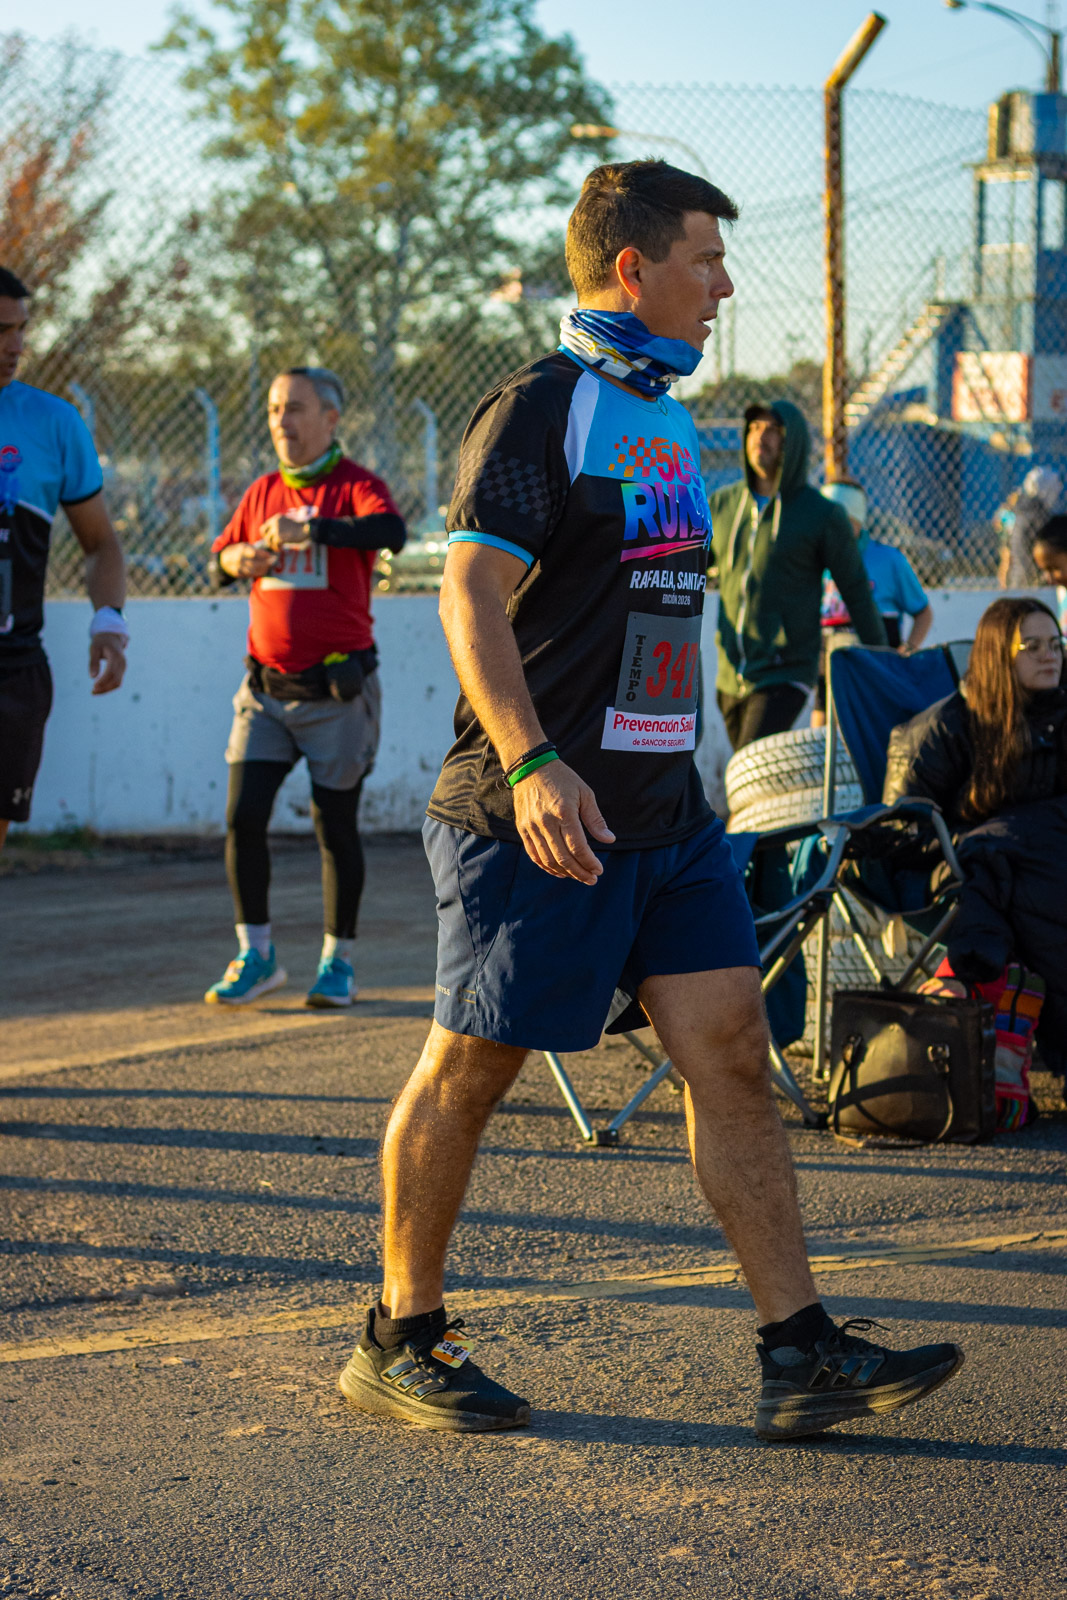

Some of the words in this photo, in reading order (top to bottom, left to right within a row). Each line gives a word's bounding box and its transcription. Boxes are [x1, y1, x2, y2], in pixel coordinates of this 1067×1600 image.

[629, 569, 676, 591] RAFAELA,
[626, 634, 646, 702] TIEMPO
[646, 641, 698, 699] 347
[613, 713, 679, 733] Prevención
[632, 738, 641, 746] de
[641, 738, 667, 747] SANCOR
[442, 1342, 464, 1356] 347
